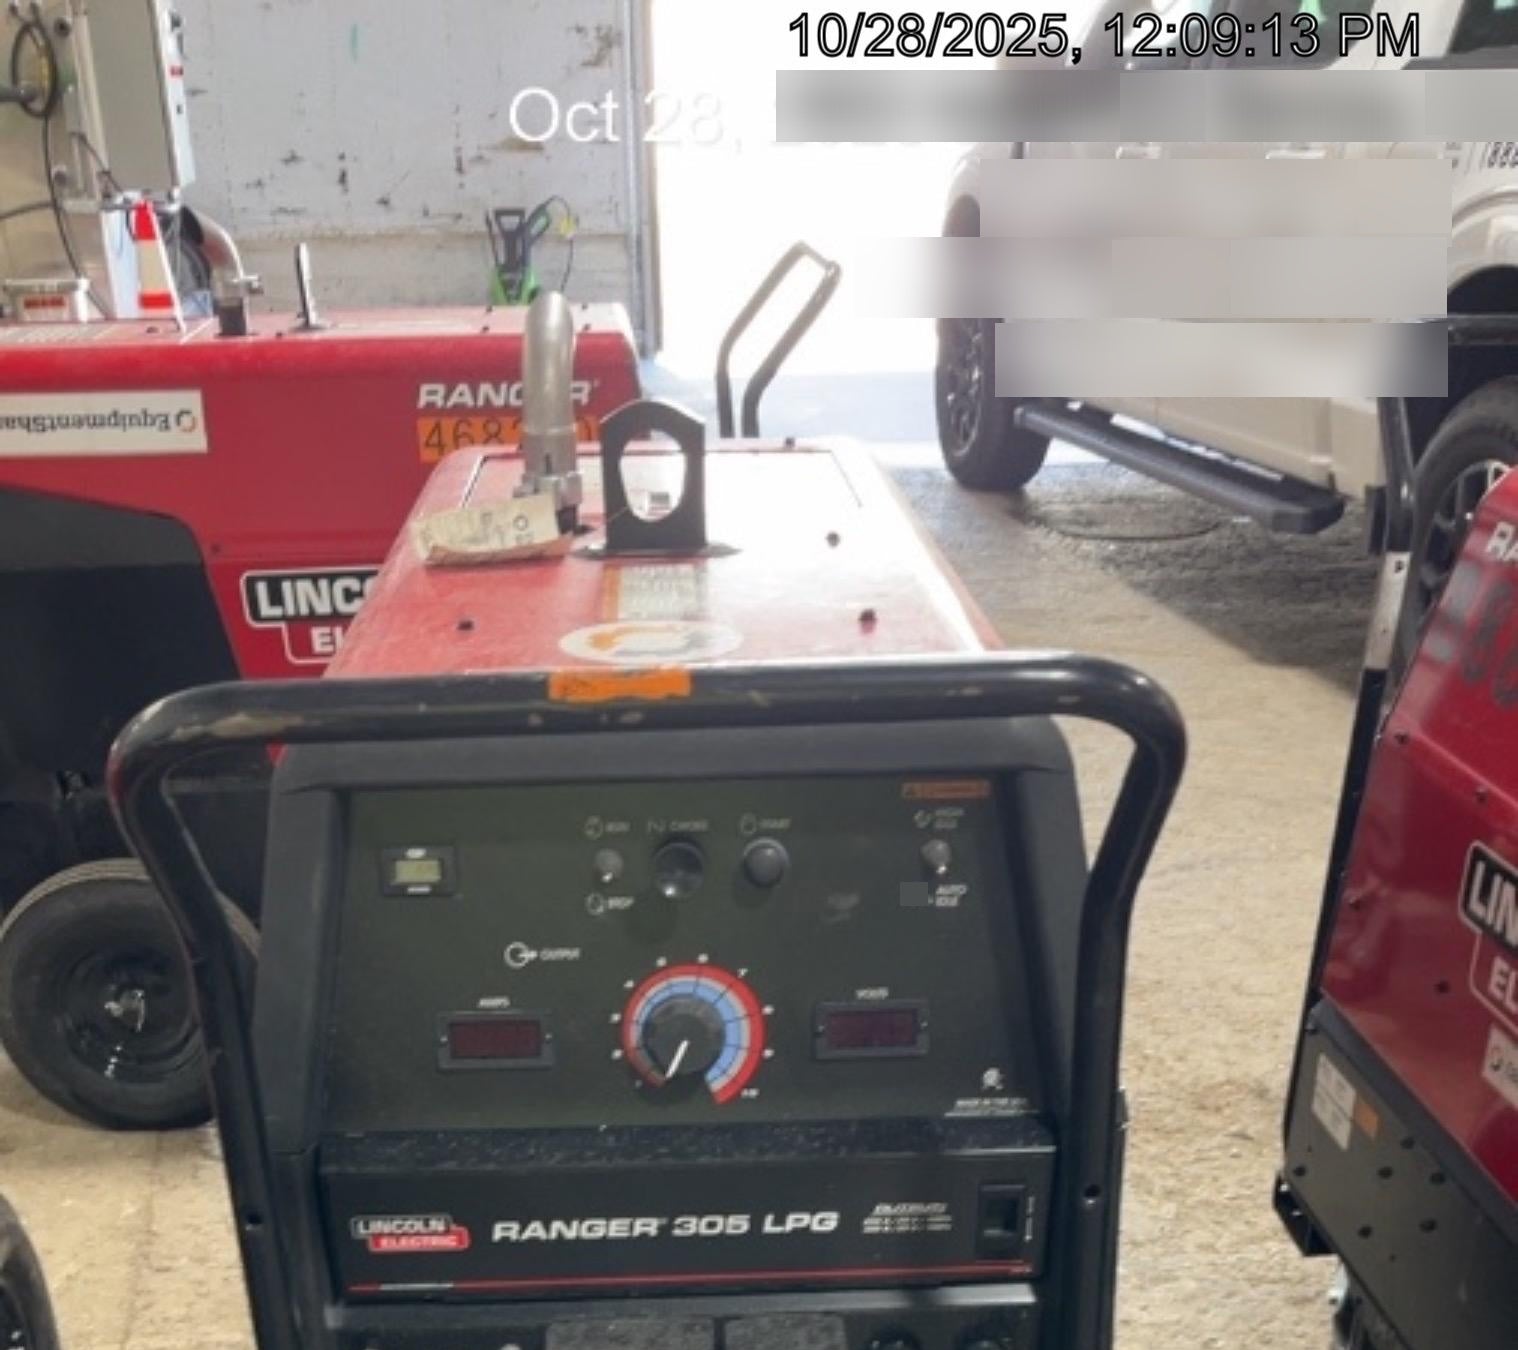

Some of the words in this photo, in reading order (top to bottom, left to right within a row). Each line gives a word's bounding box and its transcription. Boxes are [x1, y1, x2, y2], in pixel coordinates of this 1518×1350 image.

[255, 576, 377, 619] LINC
[359, 1217, 447, 1234] LINCOLN
[491, 1218, 662, 1242] RANGER
[672, 1214, 751, 1237] 305
[762, 1211, 840, 1234] LPG
[380, 1233, 458, 1247] ELECTRIC
